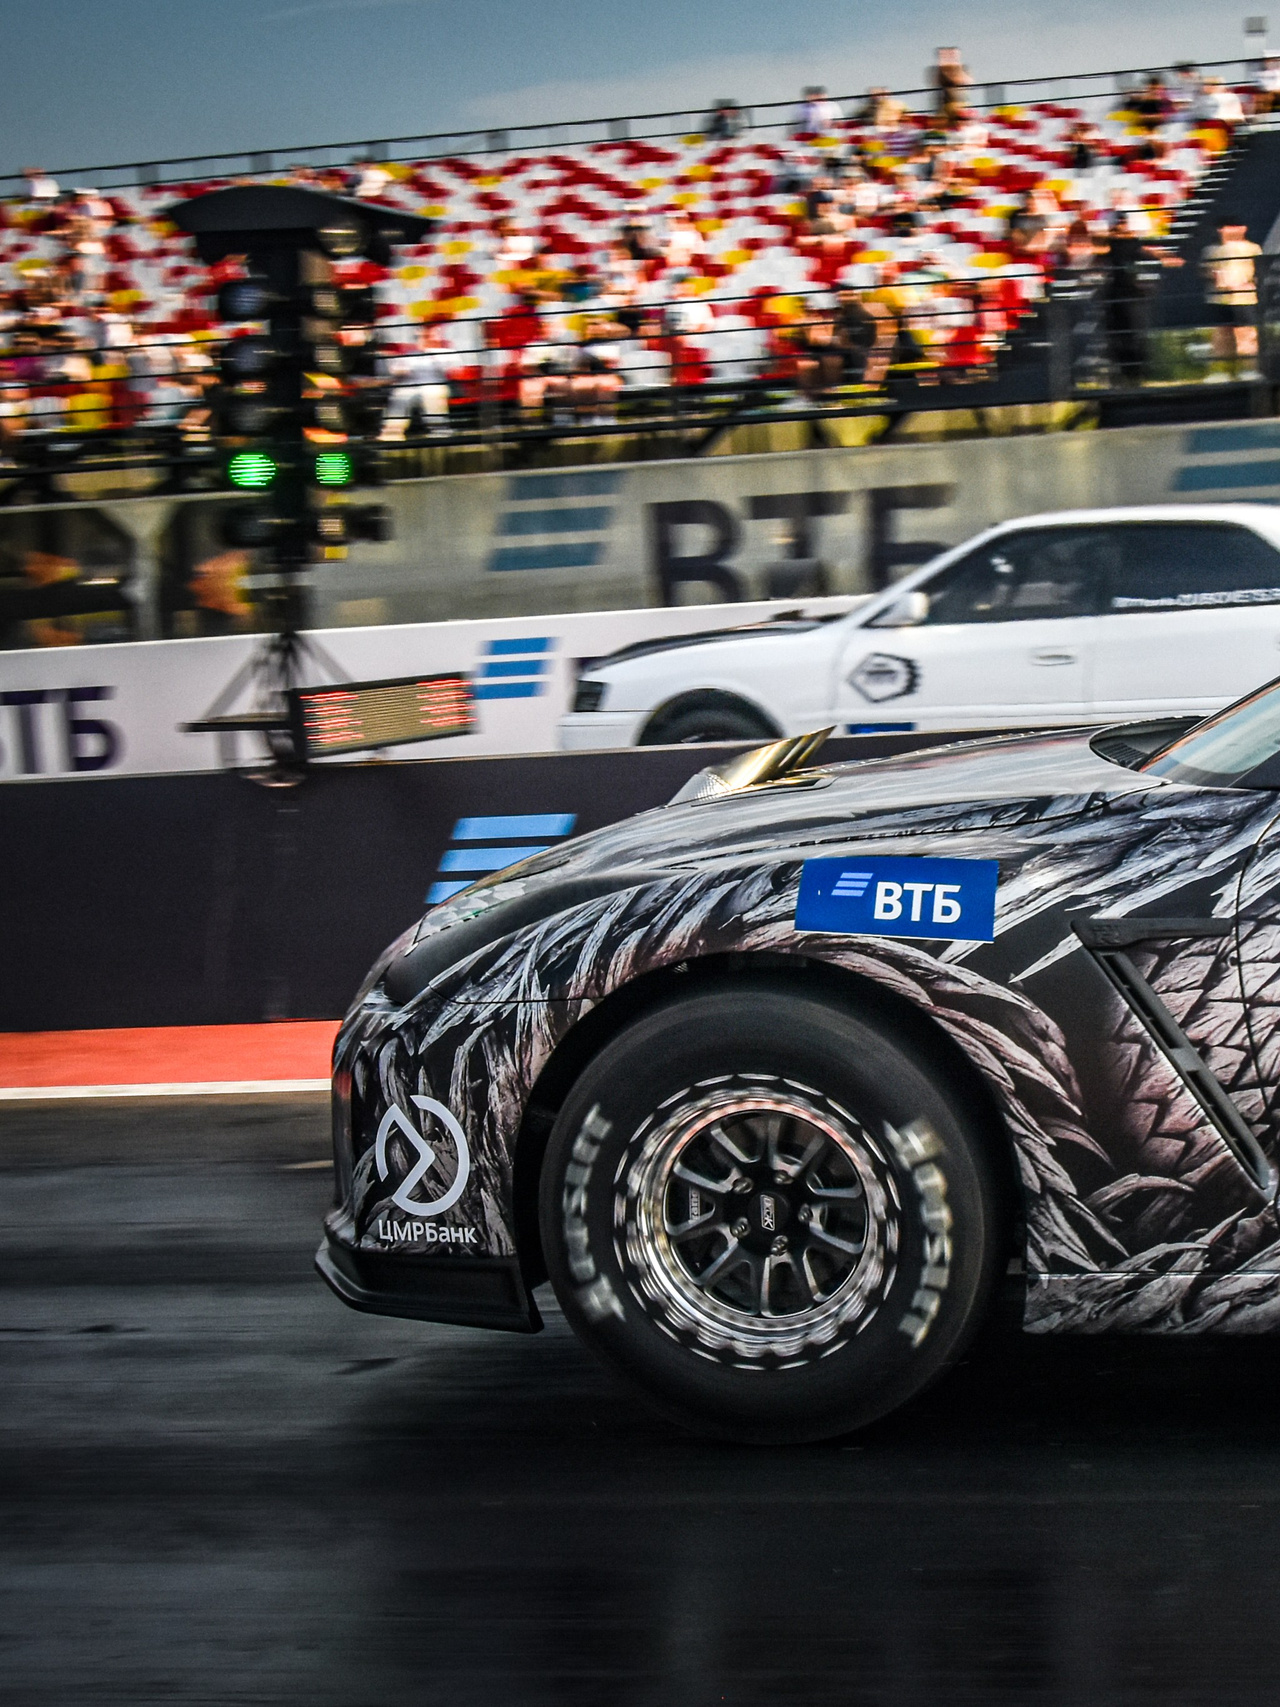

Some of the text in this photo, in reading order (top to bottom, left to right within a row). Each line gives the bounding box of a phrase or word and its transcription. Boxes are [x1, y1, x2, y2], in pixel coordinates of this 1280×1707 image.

[0, 686, 124, 775] ТБ
[873, 881, 962, 924] ВТБ
[378, 1219, 478, 1244] ЦМРБанк
